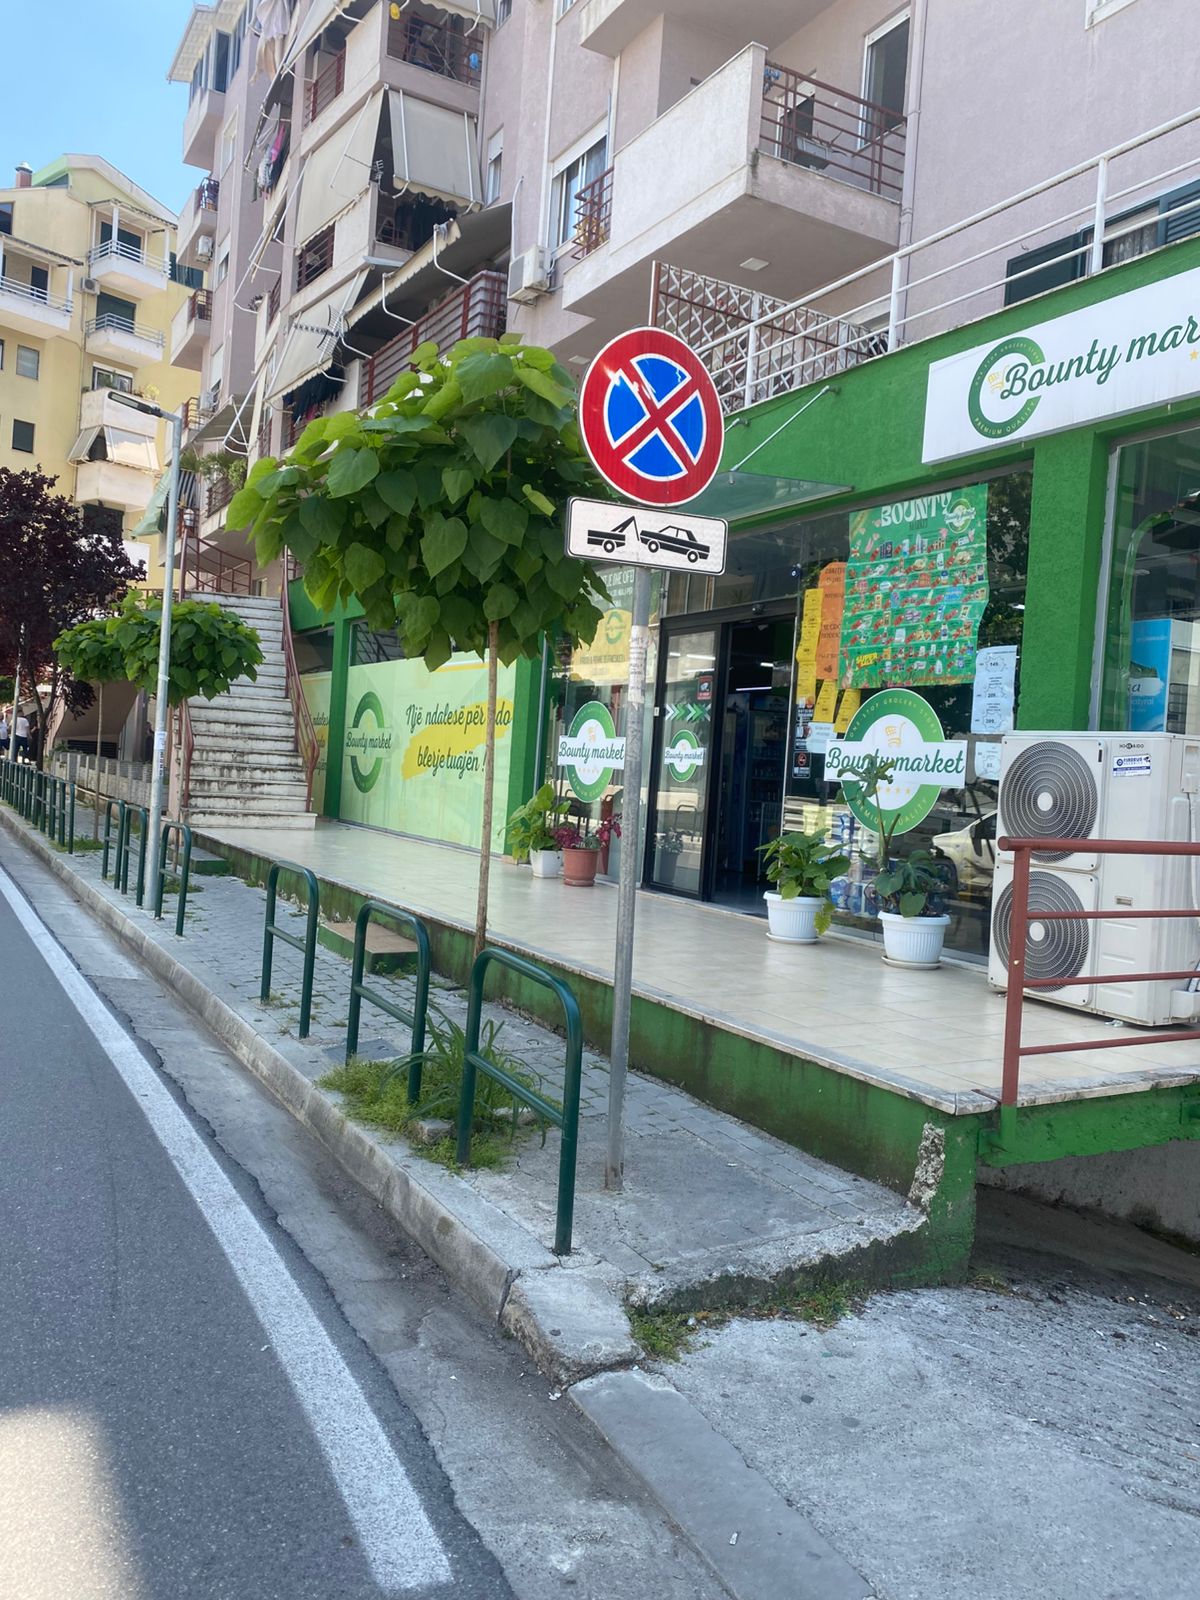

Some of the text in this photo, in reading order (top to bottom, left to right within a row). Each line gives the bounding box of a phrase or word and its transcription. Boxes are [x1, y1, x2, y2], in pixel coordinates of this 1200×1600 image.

[1000, 315, 1200, 400] Bounty mar
[880, 492, 952, 527] BOUNTY
[405, 701, 512, 735] Një ndalesë për do
[345, 731, 392, 754] Bounty market
[559, 741, 625, 764] Bounty market
[417, 745, 446, 777] blerje
[893, 749, 965, 774] market
